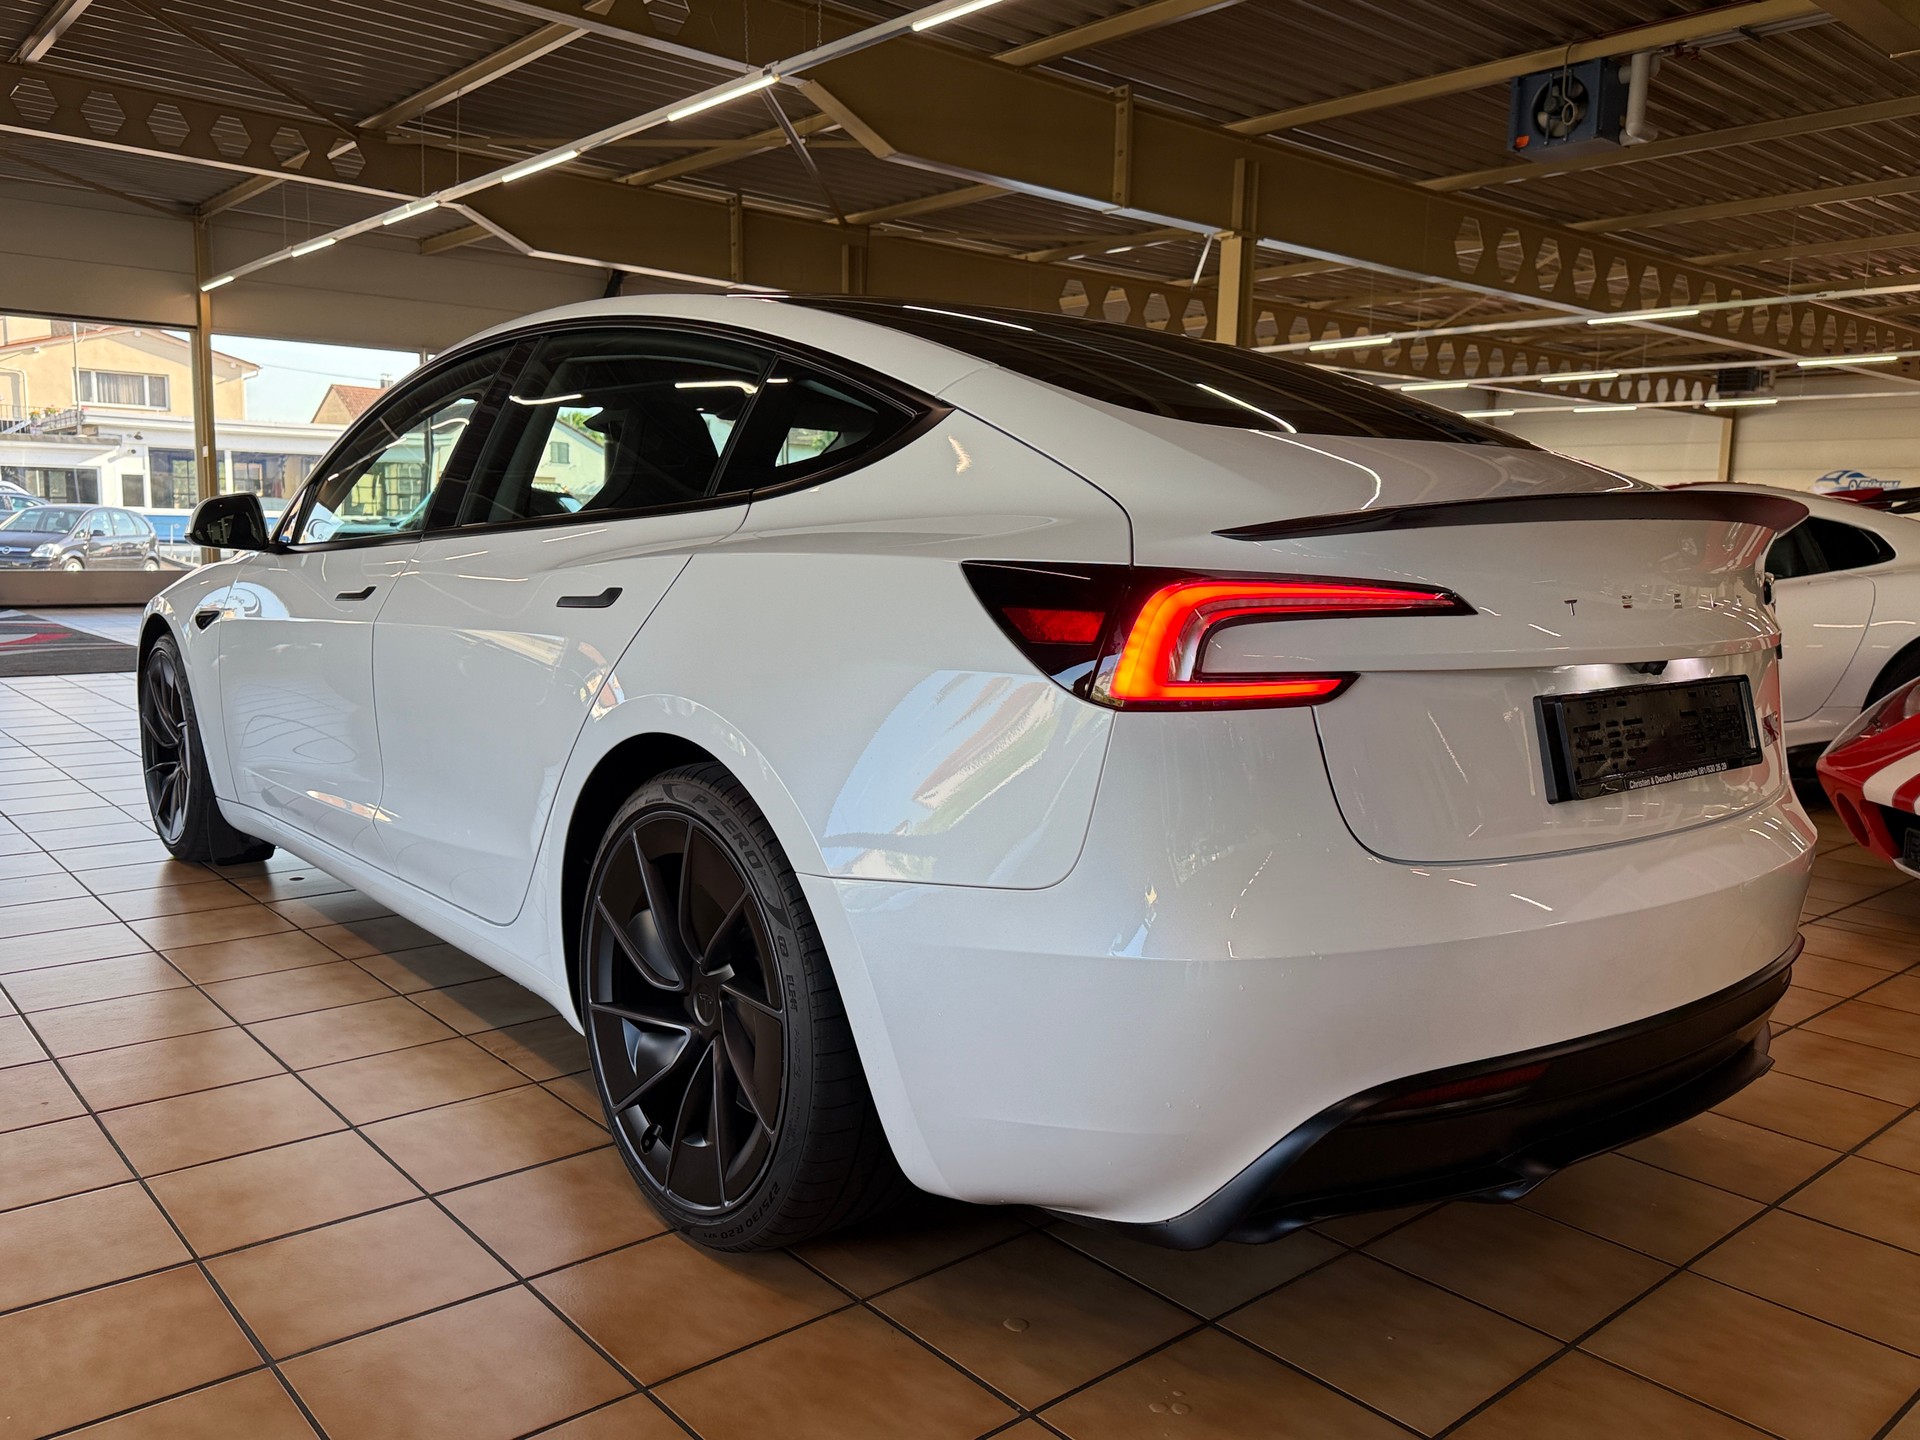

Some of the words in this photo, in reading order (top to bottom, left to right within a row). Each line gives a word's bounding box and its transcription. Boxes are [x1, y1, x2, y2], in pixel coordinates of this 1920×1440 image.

[1629, 777, 1651, 789] Christen
[1655, 773, 1673, 784] Denoth
[1673, 768, 1698, 780] Automobile
[691, 794, 709, 806] P
[707, 805, 763, 869] ZERO
[746, 1181, 781, 1227] 275/30
[720, 1225, 744, 1239] R20
